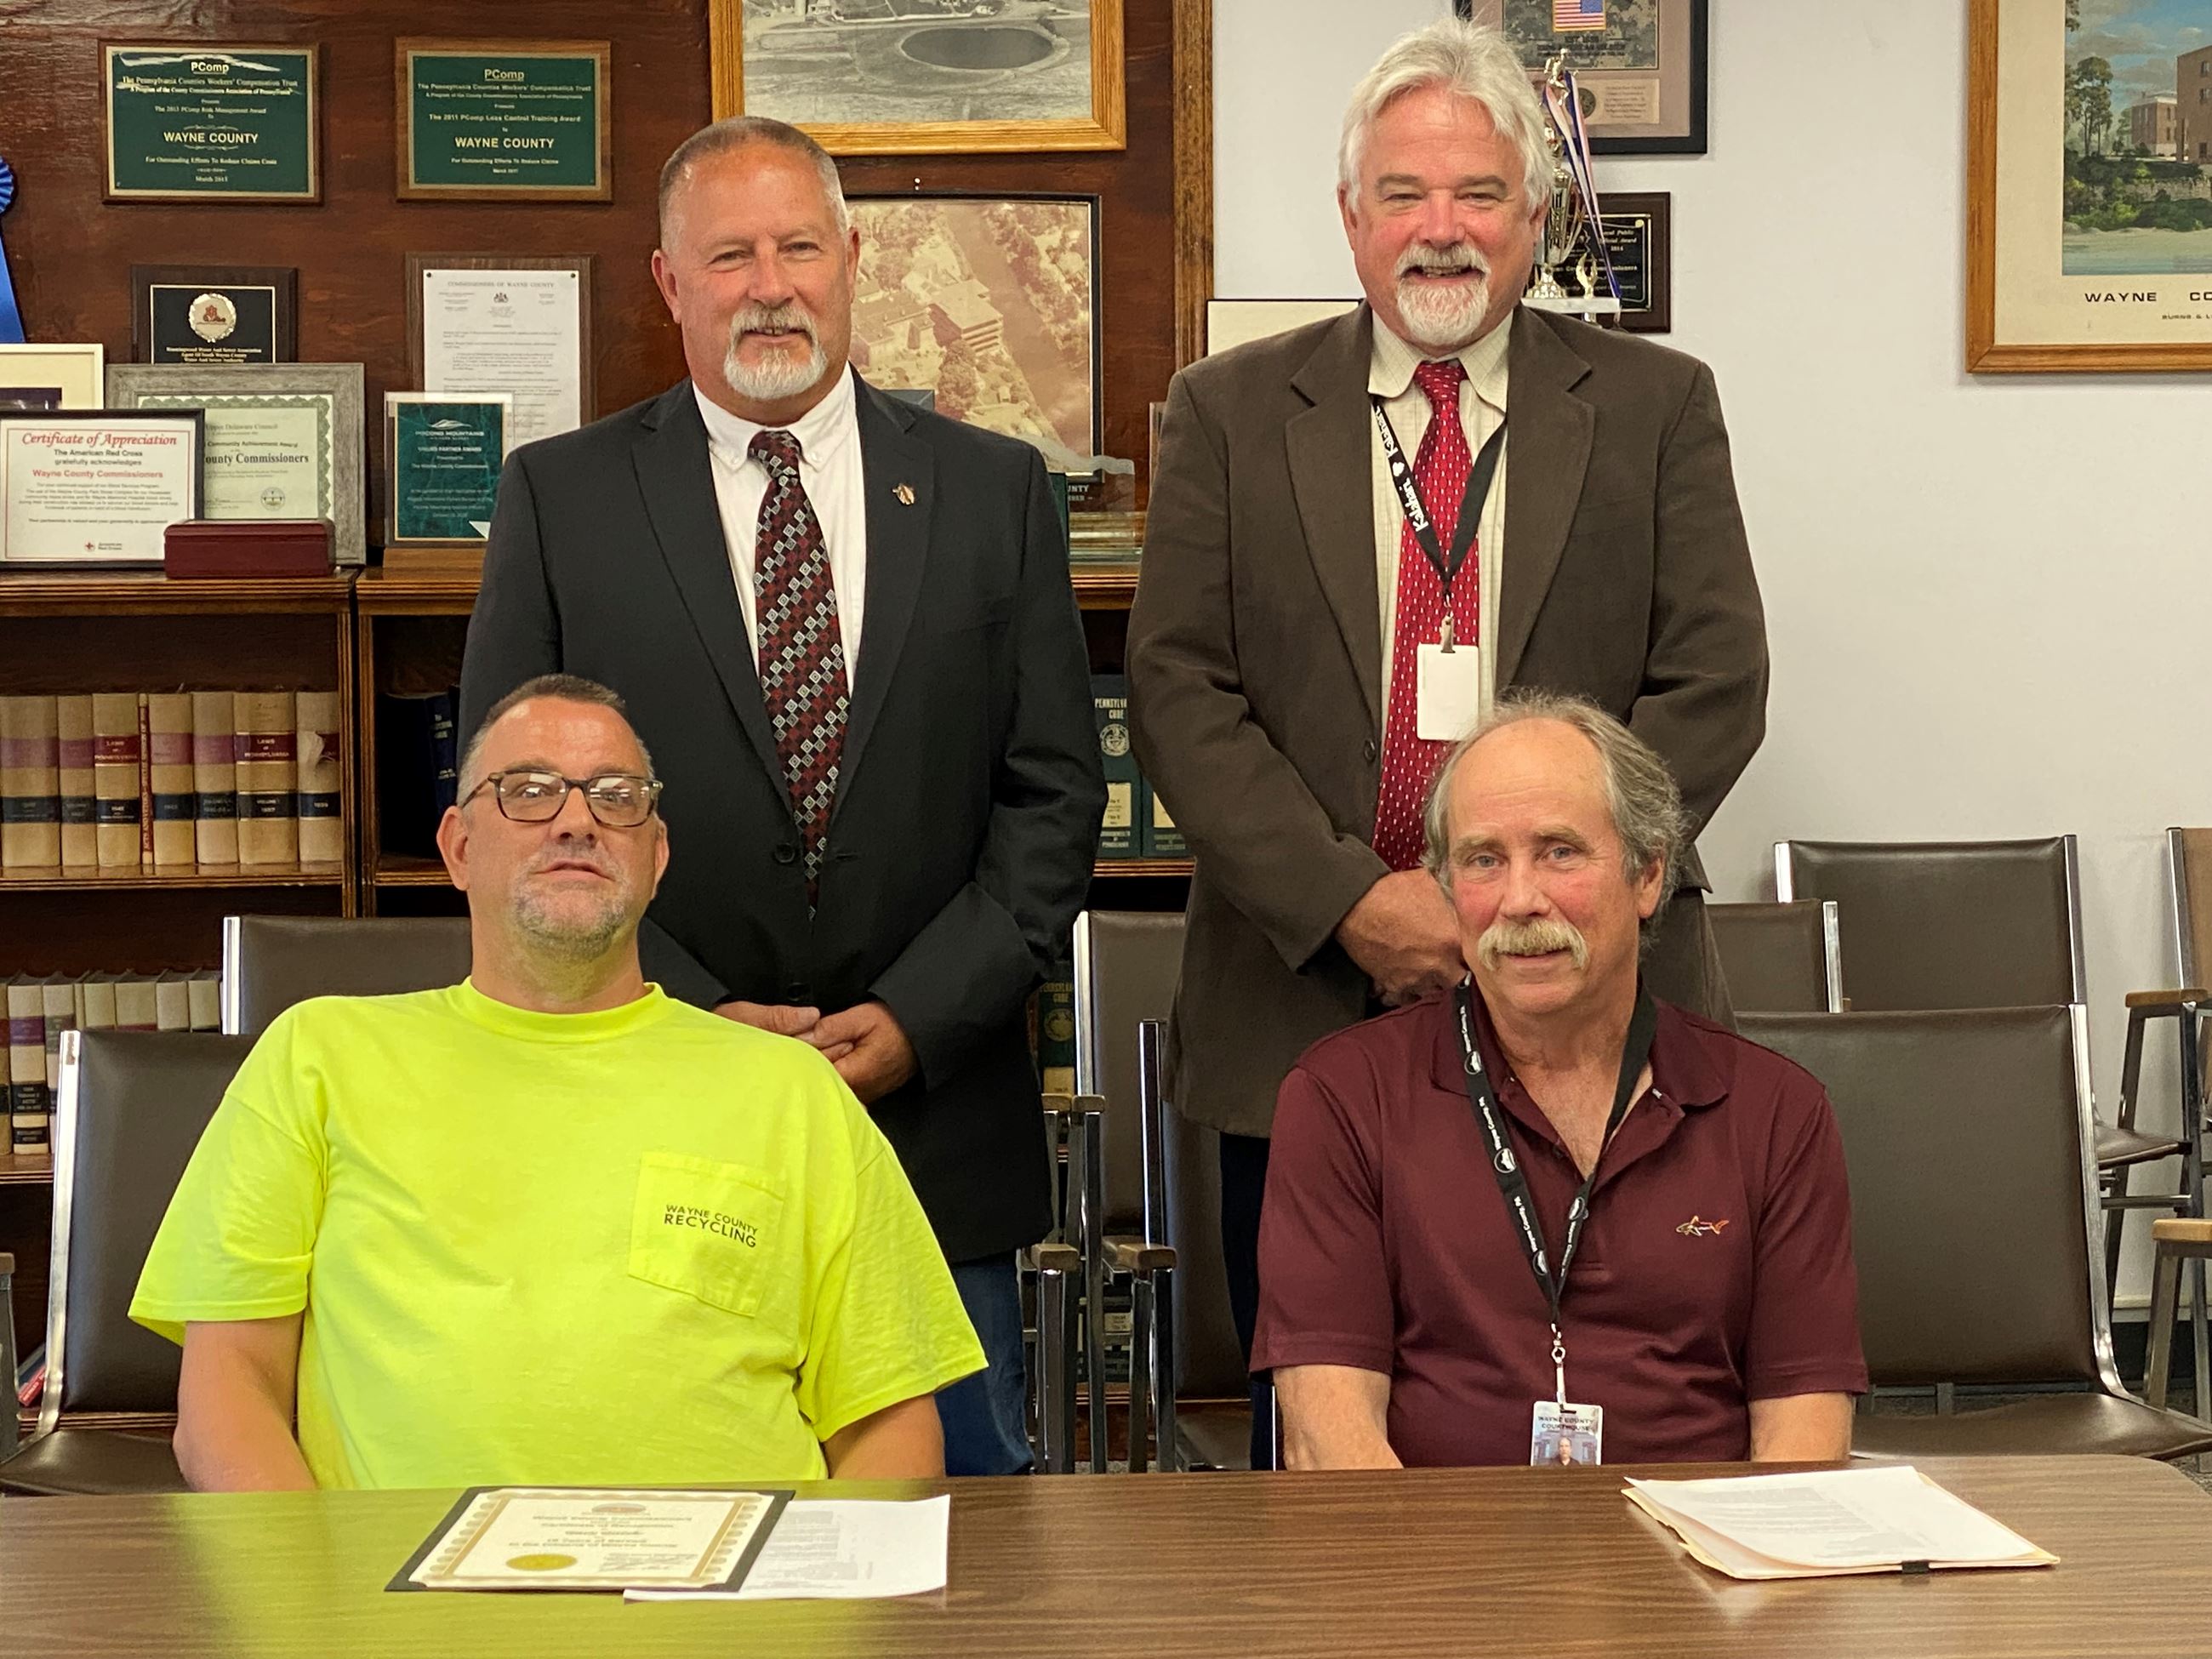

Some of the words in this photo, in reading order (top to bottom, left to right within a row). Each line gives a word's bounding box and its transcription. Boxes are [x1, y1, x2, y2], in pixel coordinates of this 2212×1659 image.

[191, 61, 230, 74] PComp
[484, 69, 525, 80] PComp
[163, 132, 206, 143] WAYNE
[208, 133, 259, 144] COUNTY
[455, 137, 499, 148] WAYNE
[503, 138, 554, 148] COUNTY
[2084, 291, 2158, 302] WAYNE
[22, 431, 83, 447] Certificate
[87, 431, 99, 446] of
[100, 433, 177, 448] Appreciation
[54, 458, 88, 466] gratefully
[236, 453, 309, 464] Commissioners
[32, 469, 62, 479] Wayne
[64, 470, 94, 479] County
[97, 470, 163, 478] Commissioners
[1399, 477, 1429, 533] Kalahari
[666, 1205, 710, 1217] WAYNE
[715, 1213, 758, 1235] COUNTY
[664, 1213, 756, 1248] RECYCLING
